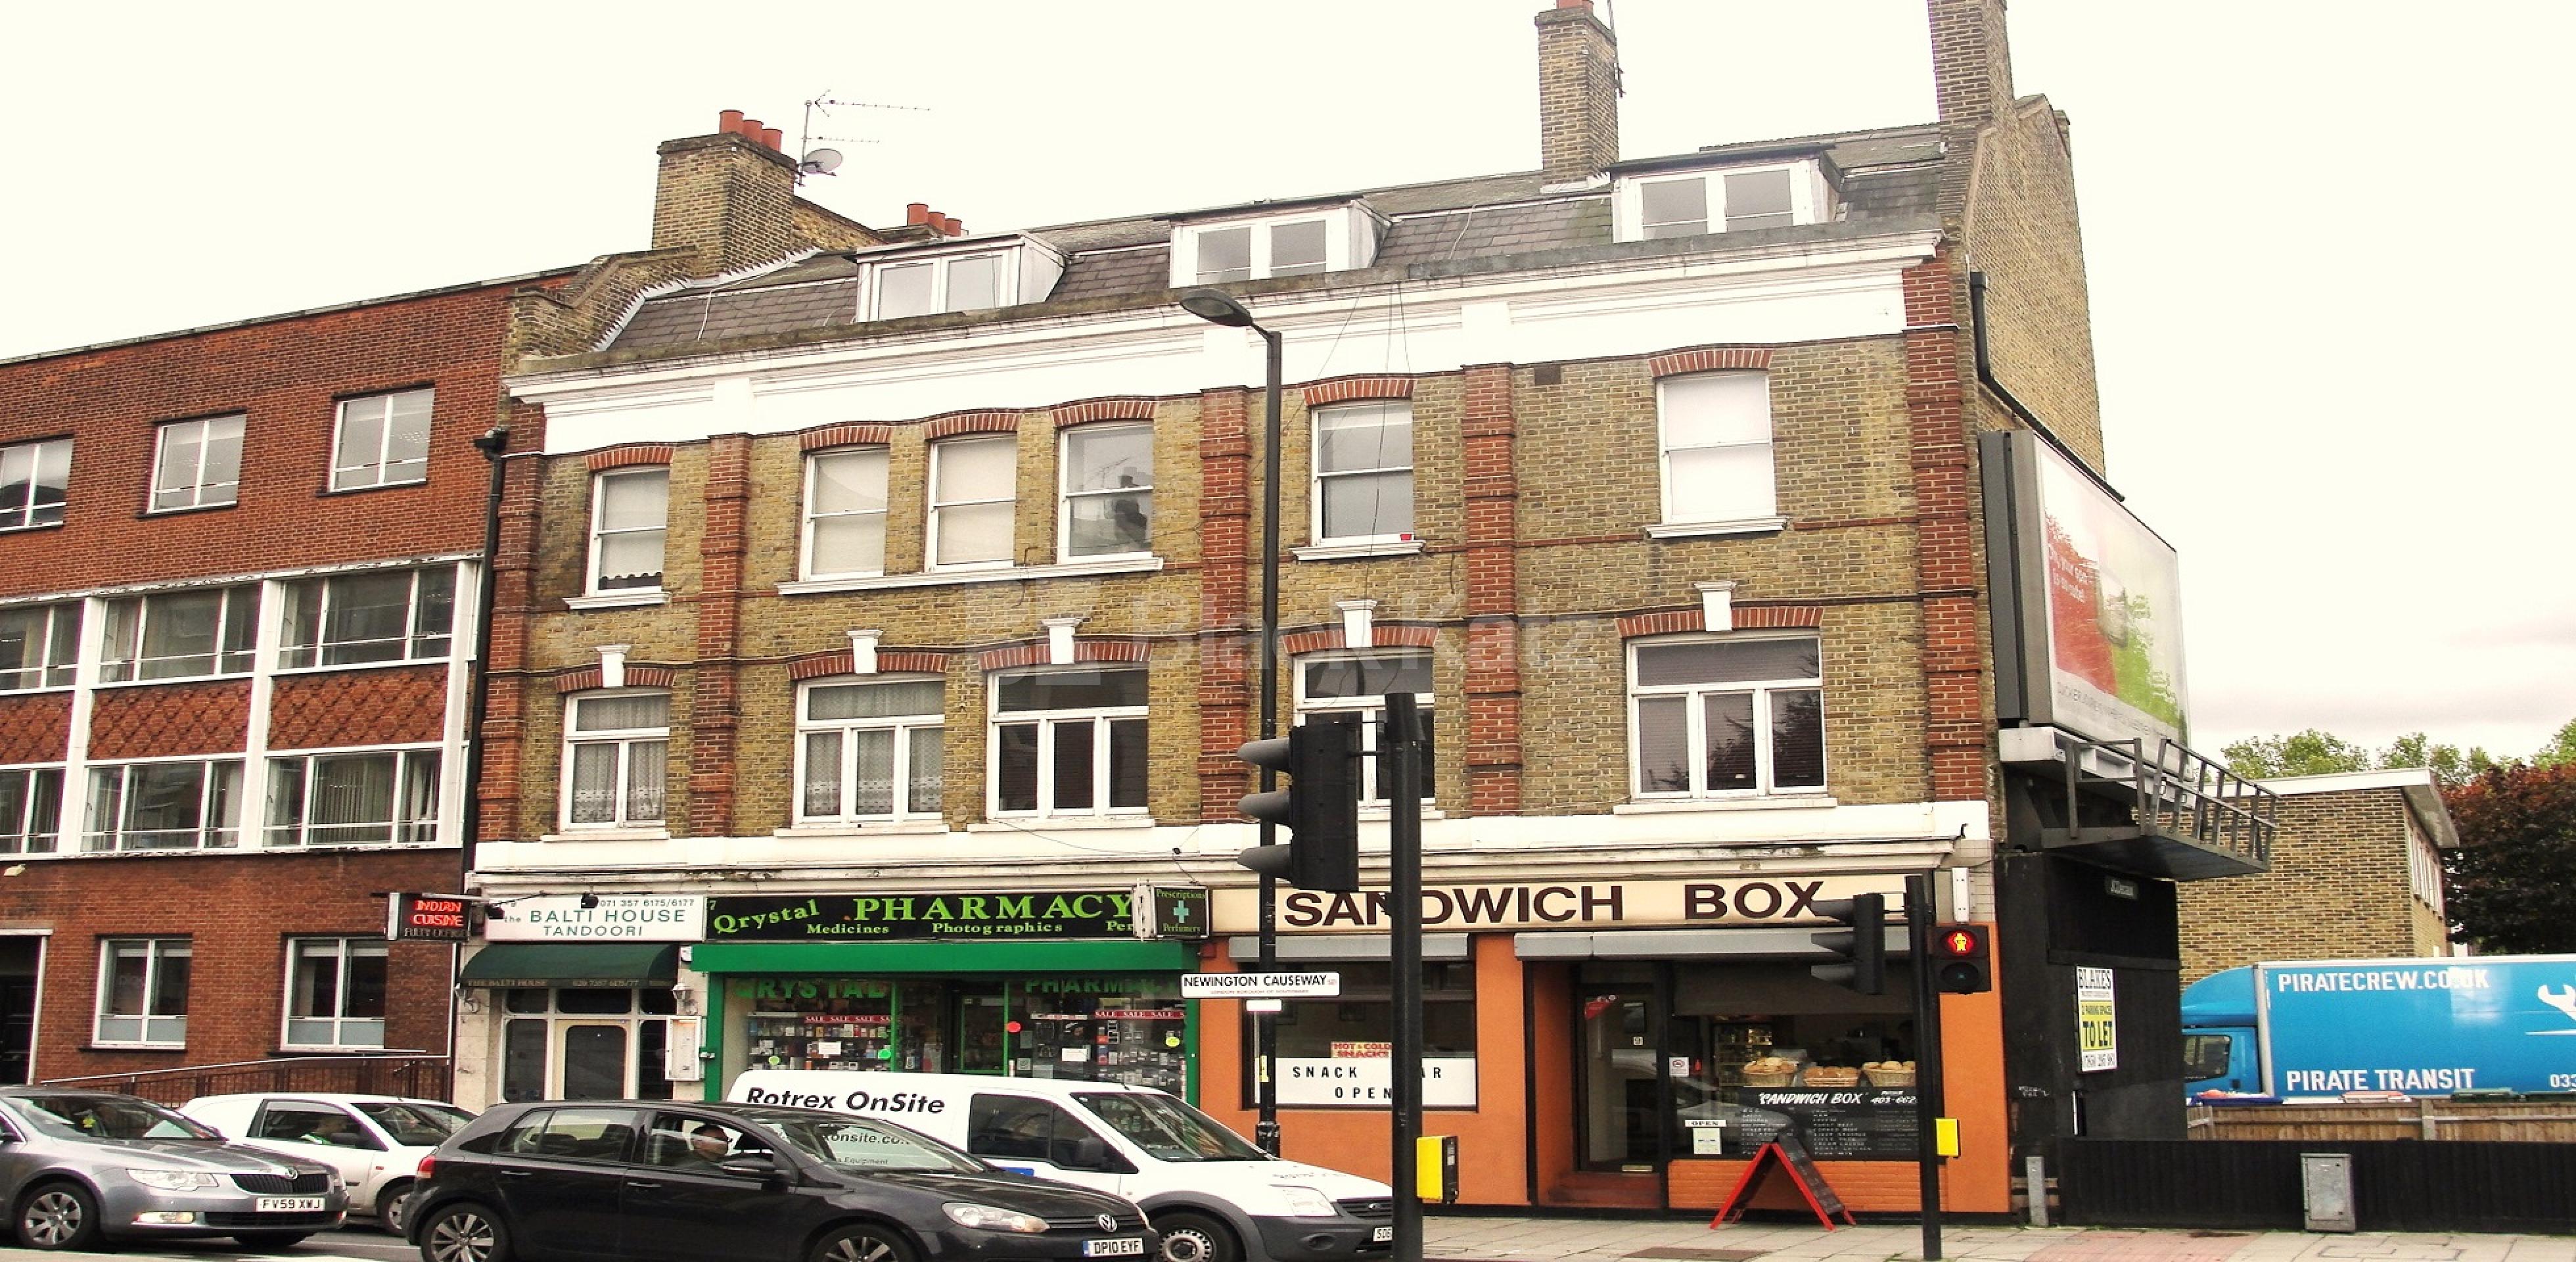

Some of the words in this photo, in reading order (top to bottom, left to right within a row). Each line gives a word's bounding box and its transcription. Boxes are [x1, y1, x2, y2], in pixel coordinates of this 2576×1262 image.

[415, 900, 462, 912] INDIAN
[643, 899, 695, 907] 6175/6177
[1684, 881, 1825, 920] BOX
[853, 895, 1133, 921] PHARMACY
[413, 914, 463, 926] CUISINE
[530, 909, 592, 922] BALTI
[605, 909, 685, 922] HOUSE
[543, 925, 642, 937] TANDOORI
[807, 923, 889, 934] Medicines
[1184, 976, 1258, 987] NEWINGTON
[1263, 975, 1327, 985] CAUSEWAY
[2082, 1021, 2096, 1047] TO
[2097, 1021, 2113, 1047] LET
[1292, 1066, 1357, 1079] SNACK
[2286, 1069, 2368, 1092] PIRATE
[2375, 1068, 2475, 1090] TRANSIT
[1335, 1087, 1392, 1099] OPEN
[747, 1087, 837, 1109] Rotrex
[846, 1090, 945, 1114] OnSite
[844, 1156, 888, 1165] Equipment
[262, 1198, 295, 1209] FV59
[299, 1199, 320, 1209] XWJ
[1093, 1242, 1119, 1255] DP10
[1121, 1240, 1141, 1253] EYF
